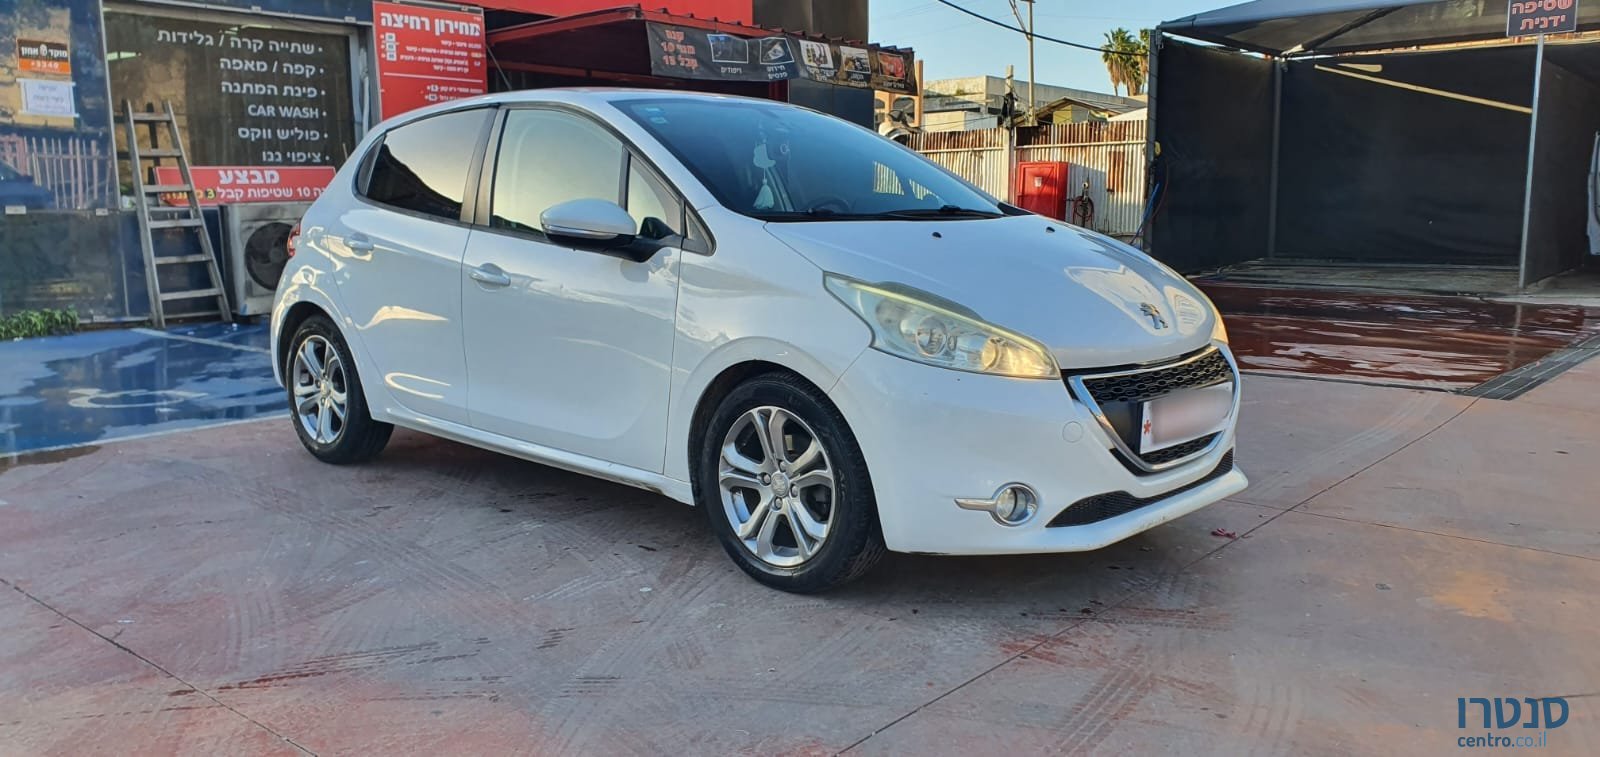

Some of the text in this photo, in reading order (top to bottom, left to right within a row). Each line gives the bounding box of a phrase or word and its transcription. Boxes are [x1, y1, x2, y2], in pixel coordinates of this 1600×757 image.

[1512, 0, 1573, 15] שטיפה
[381, 12, 480, 36] מחירון רחיצה
[1520, 14, 1566, 31] ידנית
[157, 29, 214, 46] גלידות
[230, 35, 264, 53] קרה
[269, 39, 315, 54] שתייה
[219, 57, 268, 72] מאפה
[282, 62, 316, 78] קפה
[221, 80, 318, 98] פינת המתנה
[247, 104, 319, 118] CAR WASH
[237, 127, 320, 141] פוליש ווקס
[262, 151, 322, 163] ציפוי ננו
[218, 169, 280, 185] מבצע
[206, 188, 215, 199] 3
[216, 186, 244, 201] קבל
[247, 187, 293, 199] שטיפות
[297, 186, 311, 197] 10
